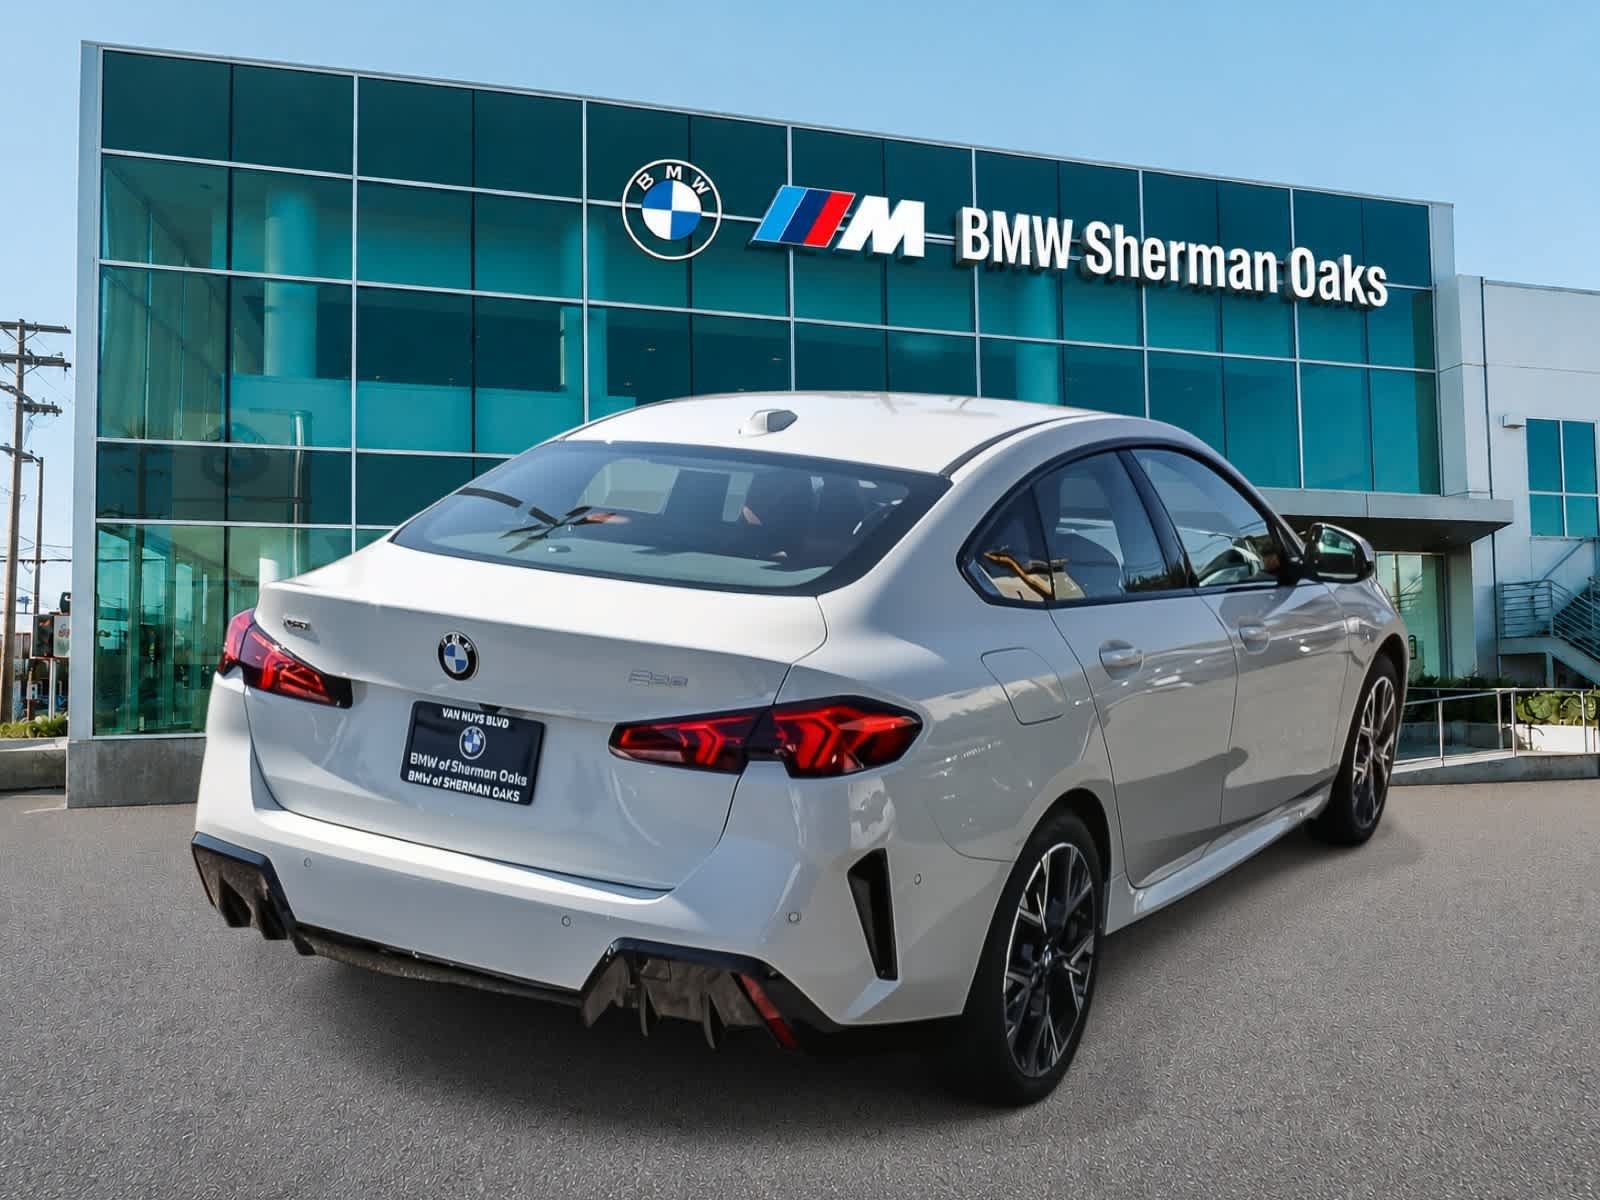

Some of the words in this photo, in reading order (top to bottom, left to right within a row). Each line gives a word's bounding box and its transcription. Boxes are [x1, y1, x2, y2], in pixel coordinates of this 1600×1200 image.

[636, 165, 711, 195] BMW
[837, 195, 925, 258] M
[960, 206, 1073, 269] BMW
[1085, 220, 1278, 293] Sherman
[1291, 246, 1388, 307] Oaks
[442, 708, 460, 720] VAN
[461, 713, 485, 724] NUYS
[486, 717, 509, 729] BLVD
[410, 752, 438, 769] BMW
[438, 760, 451, 771] of
[451, 761, 497, 781] Sherman
[500, 770, 528, 786] Oaks
[408, 770, 432, 785] BMW
[432, 775, 443, 786] of
[443, 777, 491, 796] SHERMAN
[492, 787, 520, 802] OAKS
